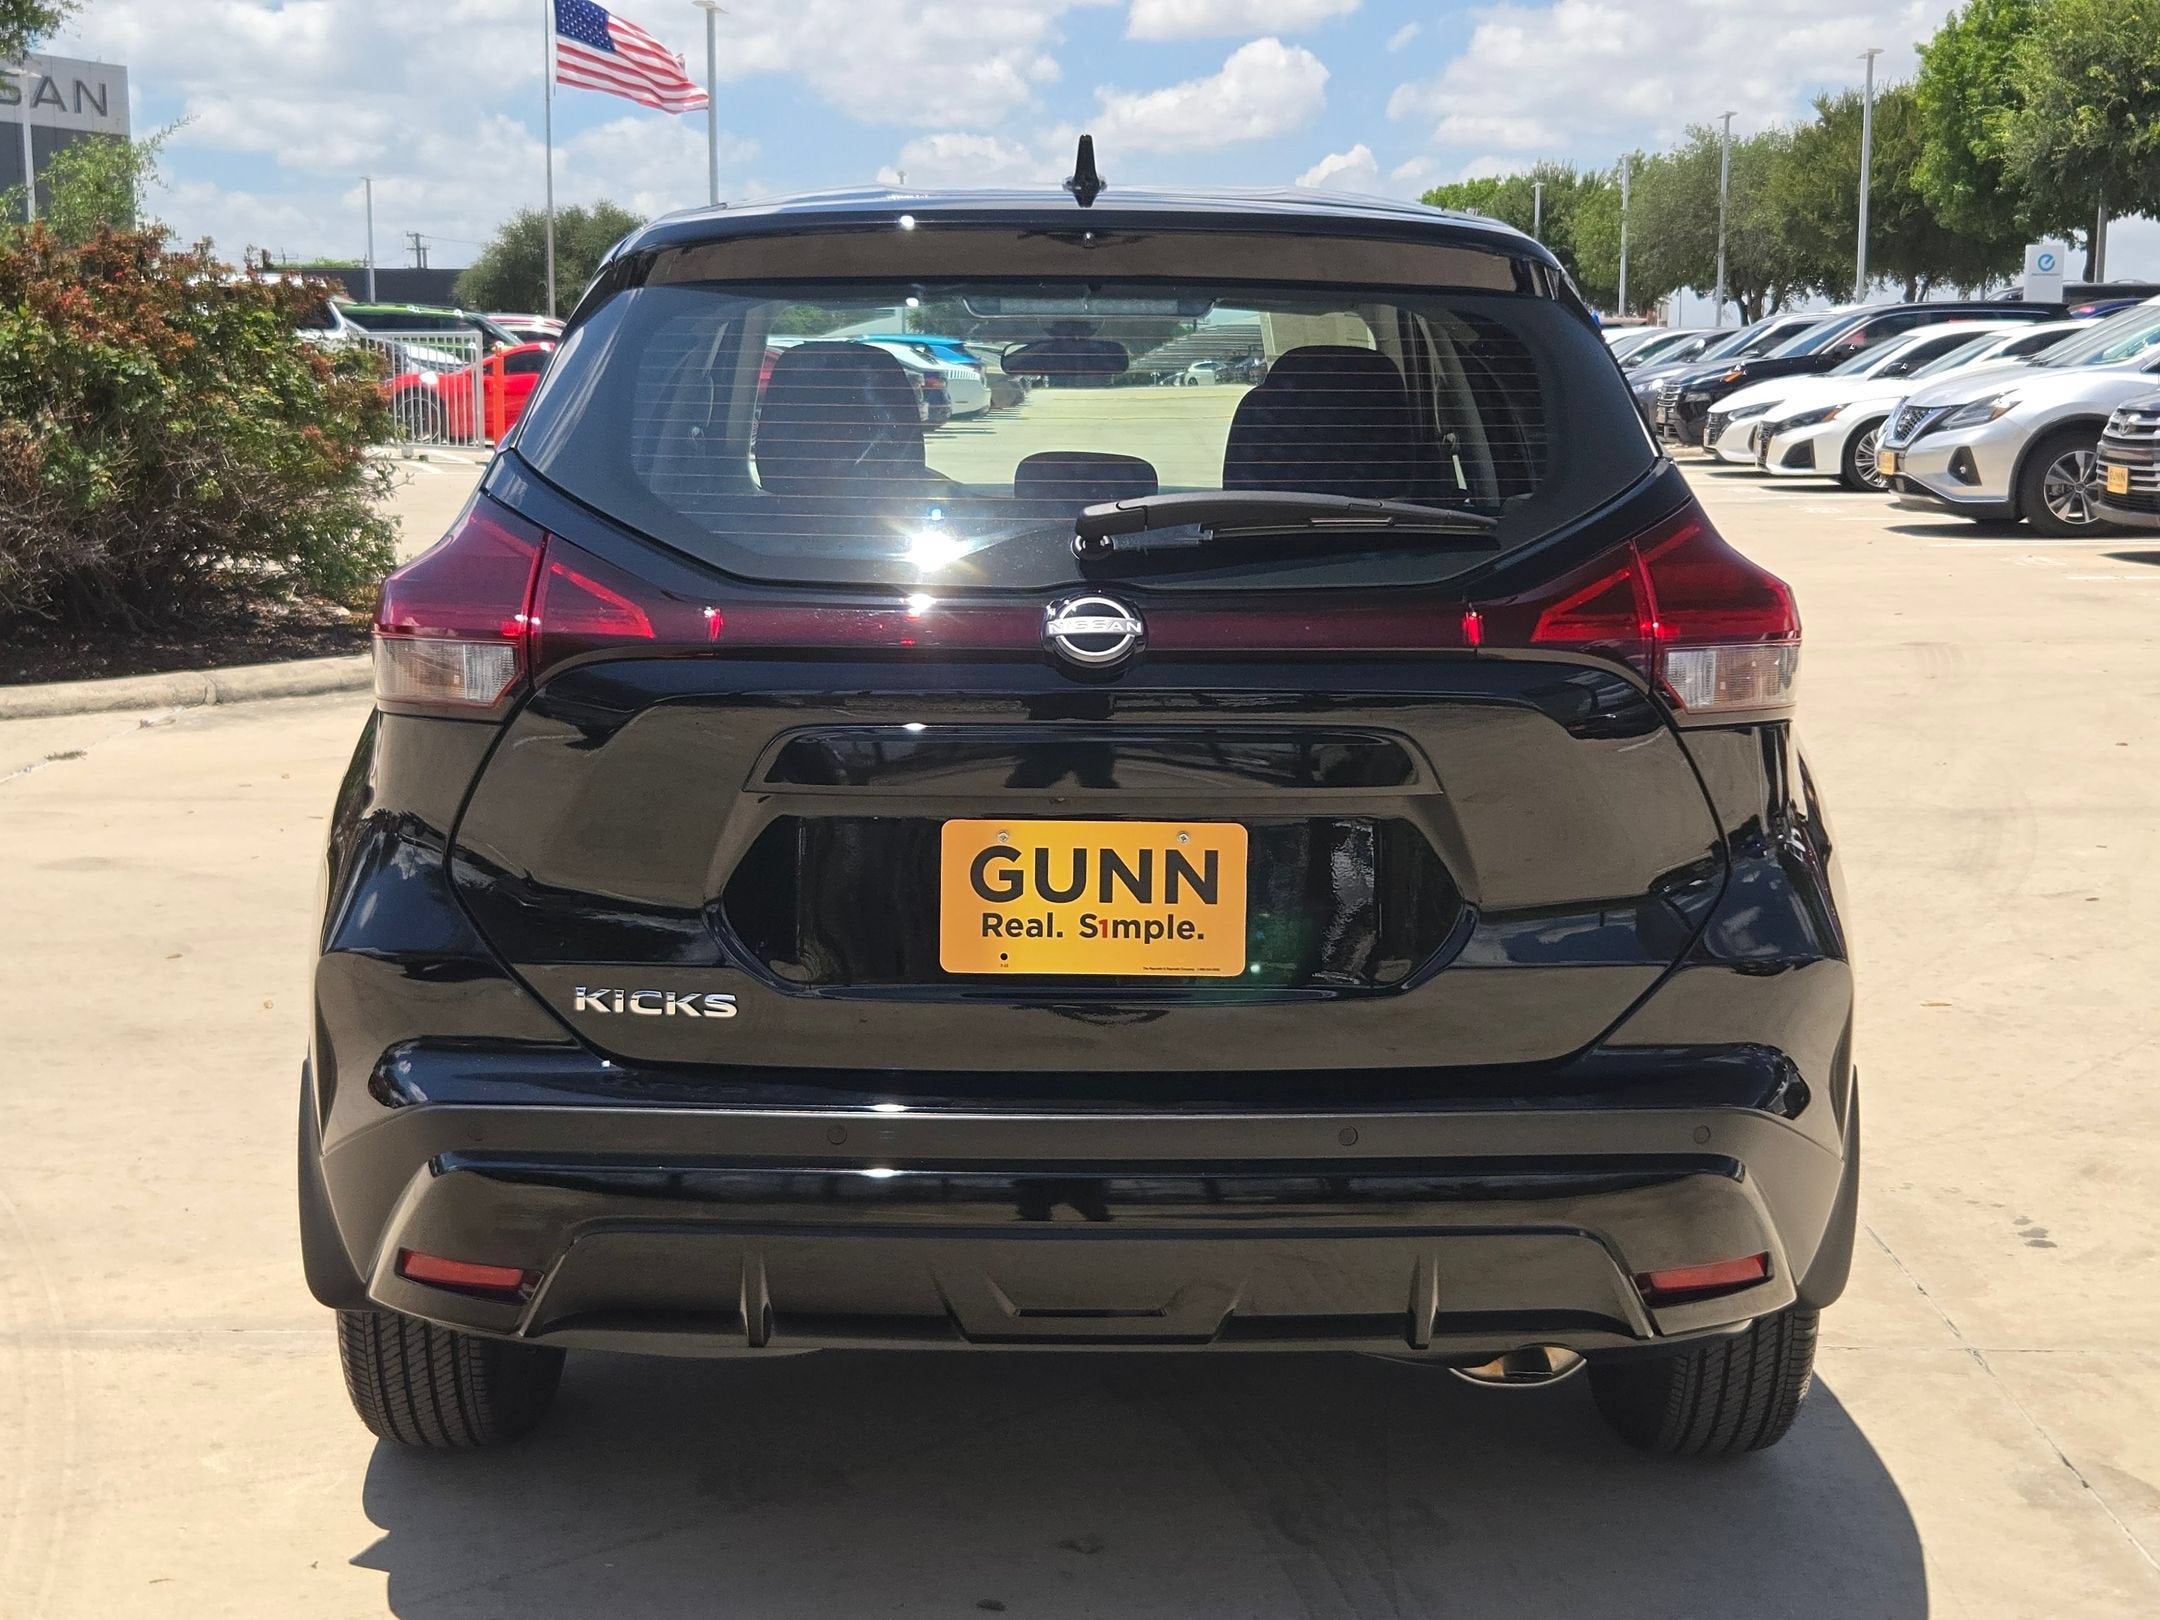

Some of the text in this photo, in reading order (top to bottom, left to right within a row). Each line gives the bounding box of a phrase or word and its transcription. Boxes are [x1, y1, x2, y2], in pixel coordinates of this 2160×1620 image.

[970, 845, 1219, 905] GUNN
[982, 912, 1205, 945] Real. S1mple.
[575, 986, 738, 1018] KICKS
